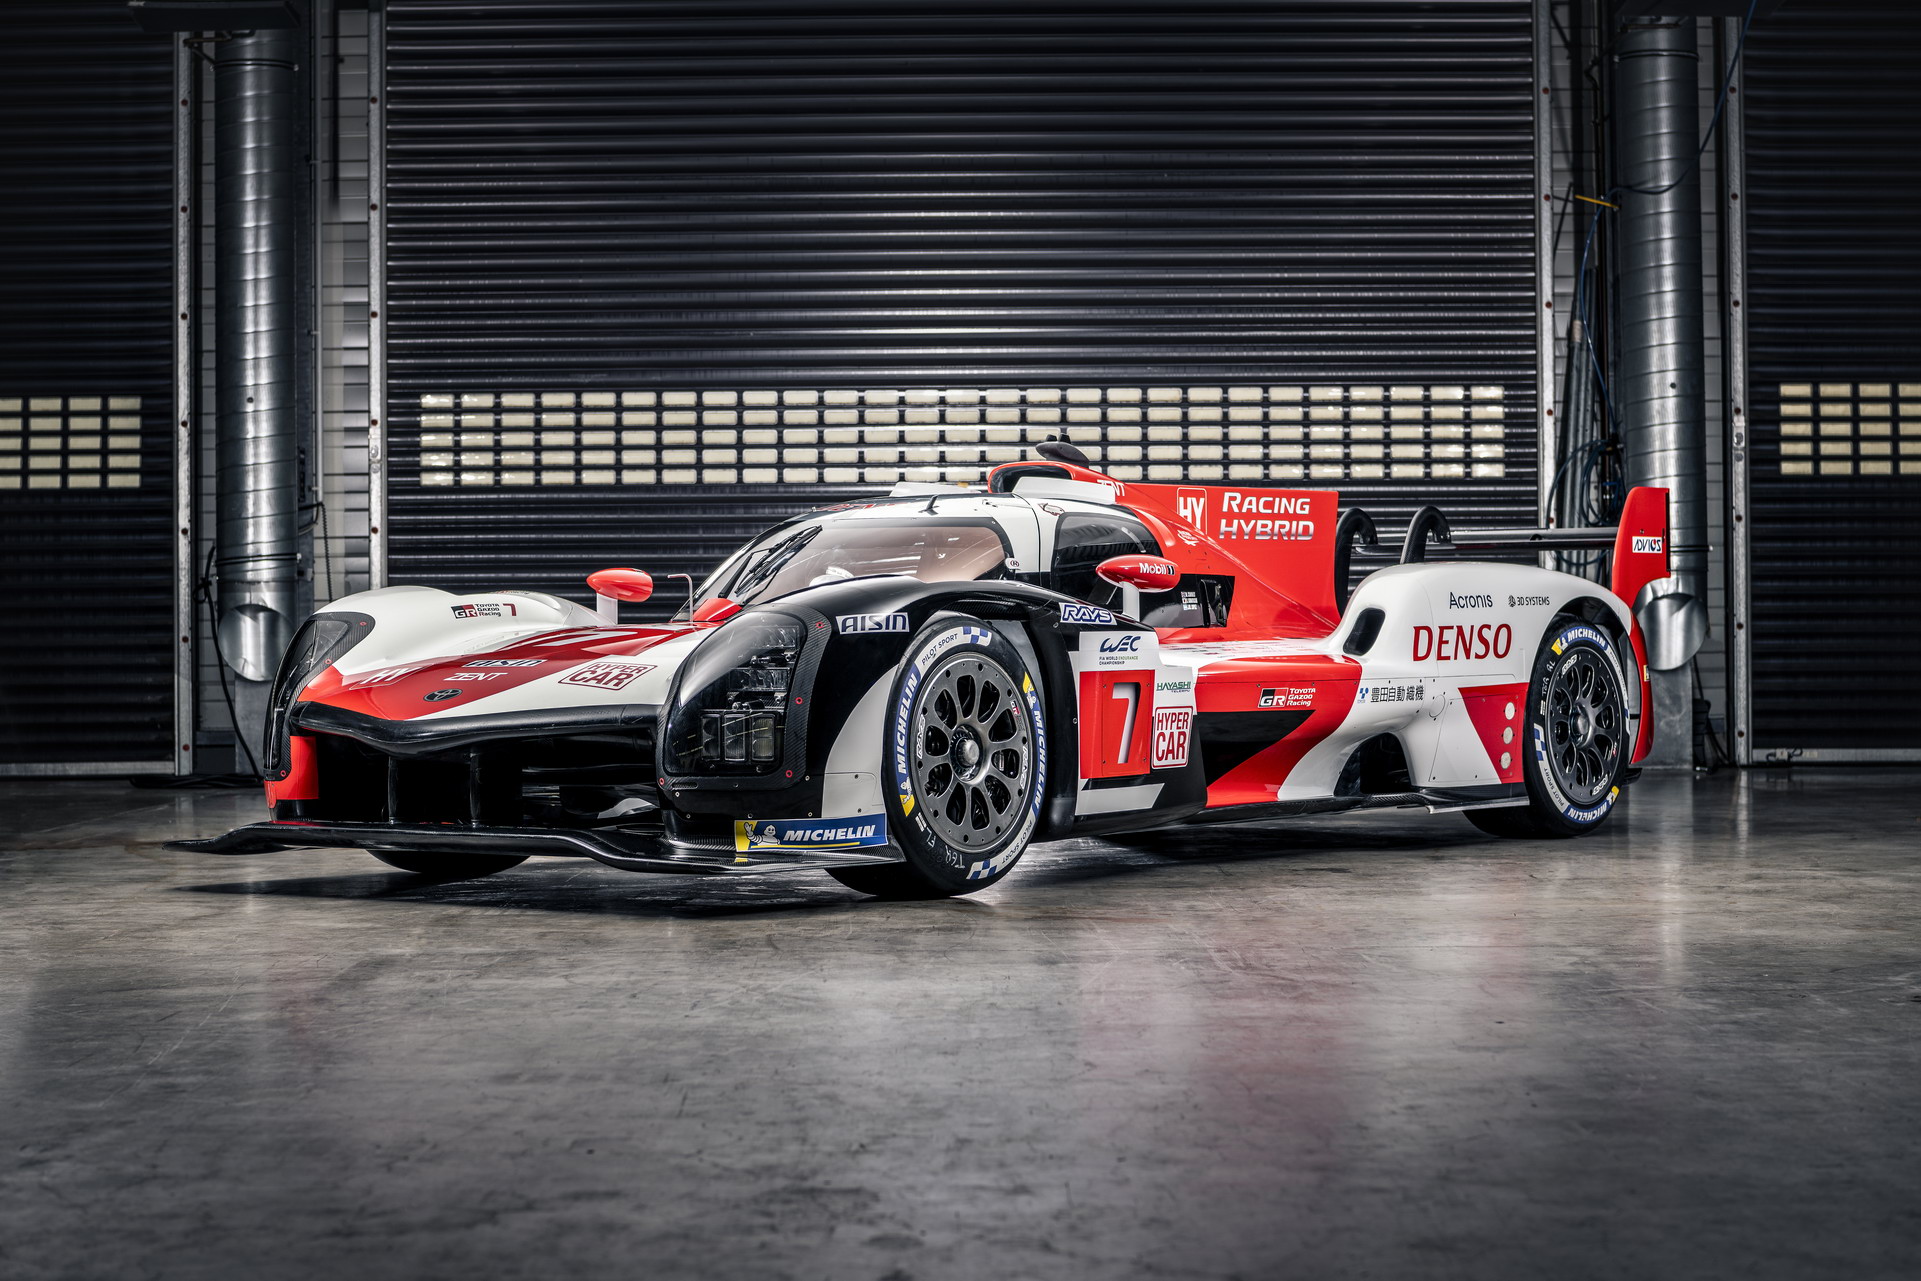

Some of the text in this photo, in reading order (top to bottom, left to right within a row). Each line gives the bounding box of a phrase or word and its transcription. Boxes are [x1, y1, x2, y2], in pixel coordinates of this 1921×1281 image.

[1096, 479, 1126, 496] NT
[1222, 492, 1311, 514] RACING
[1179, 497, 1205, 529] HY
[1219, 519, 1314, 540] HYBRID
[1139, 563, 1166, 575] Mobil
[503, 603, 517, 616] 7
[1449, 592, 1493, 609] Acronis
[1517, 596, 1550, 606] 3D SYSTEMS
[454, 609, 476, 618] GR
[1062, 604, 1112, 623] RAYS
[841, 614, 907, 632] AISIN
[1100, 635, 1141, 652] WEC
[1413, 624, 1512, 661] DENSO
[1567, 628, 1606, 647] MICHELIN
[921, 633, 958, 665] PILOT SPORT
[360, 667, 422, 684] HY
[444, 673, 508, 681] ZENT
[589, 663, 645, 674] HYPER
[569, 670, 634, 687] CAR
[1156, 682, 1191, 691] HAYASHI
[1260, 696, 1286, 706] GR
[897, 673, 918, 774] MICHELIN
[1112, 682, 1141, 764] 7
[1157, 712, 1189, 730] HYPER
[1156, 731, 1187, 761] CAR
[1033, 710, 1047, 810] MICHELIN
[1567, 802, 1608, 821] MICHELIN
[783, 825, 876, 841] MICHELIN
[1002, 819, 1033, 864] PILOT SPORT
